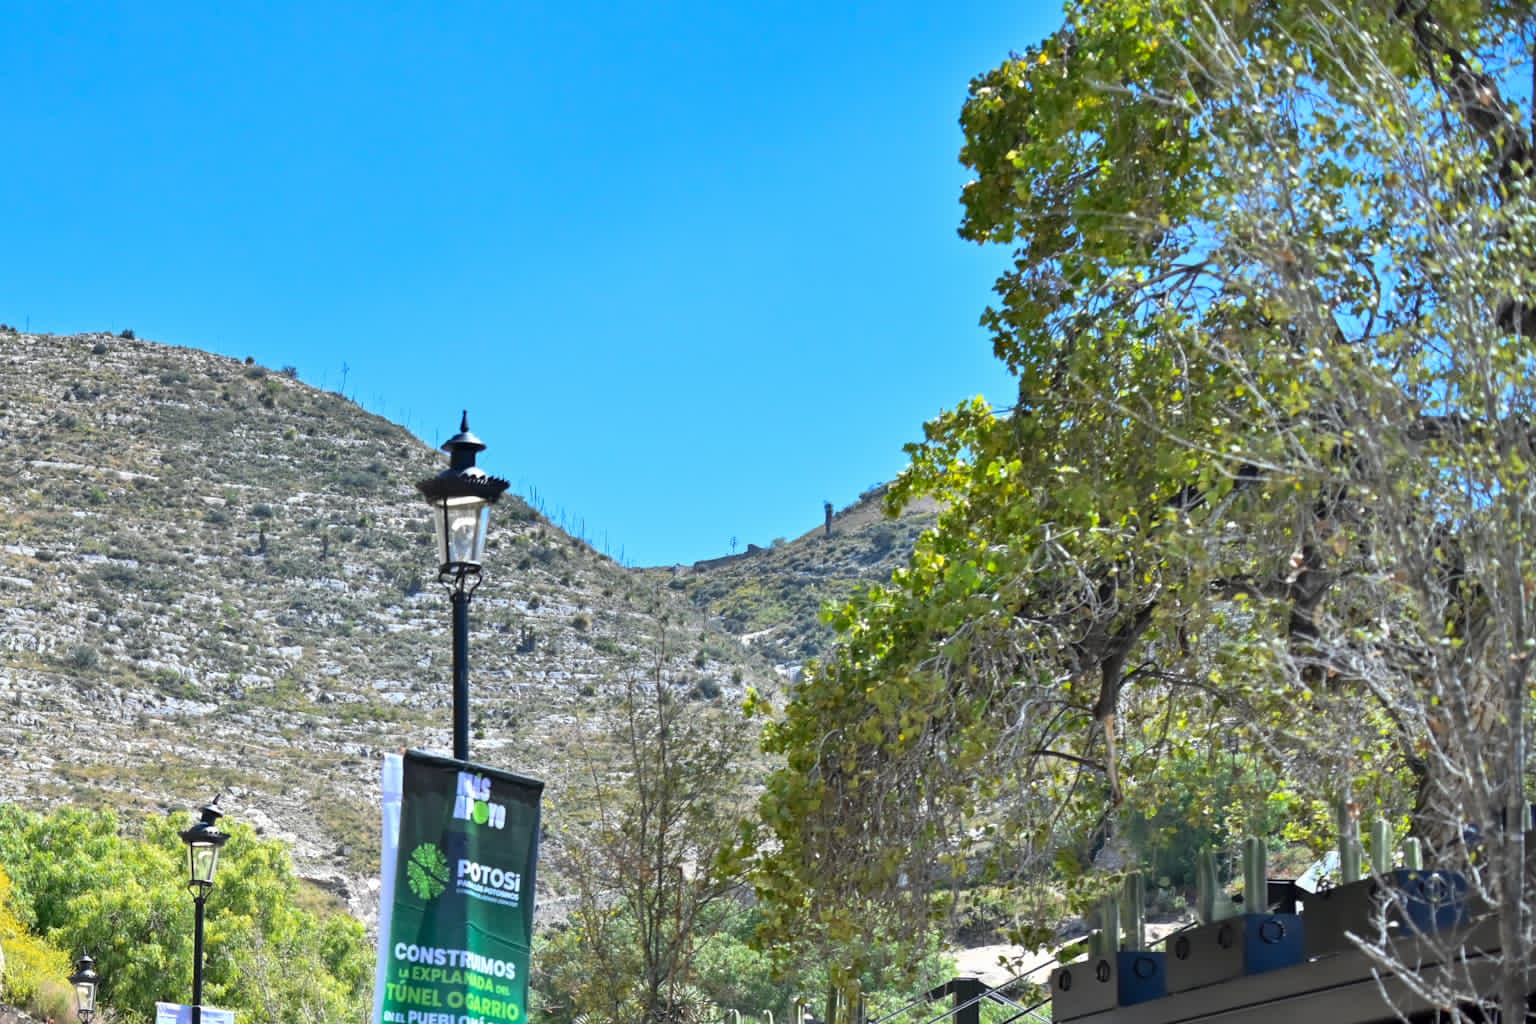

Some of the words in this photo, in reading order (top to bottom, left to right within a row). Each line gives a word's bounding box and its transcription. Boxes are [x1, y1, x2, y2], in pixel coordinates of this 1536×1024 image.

[394, 942, 515, 980] CONSTRUIMOS
[387, 979, 442, 1007] TÚNEL
[447, 991, 519, 1021] OGARRIO
